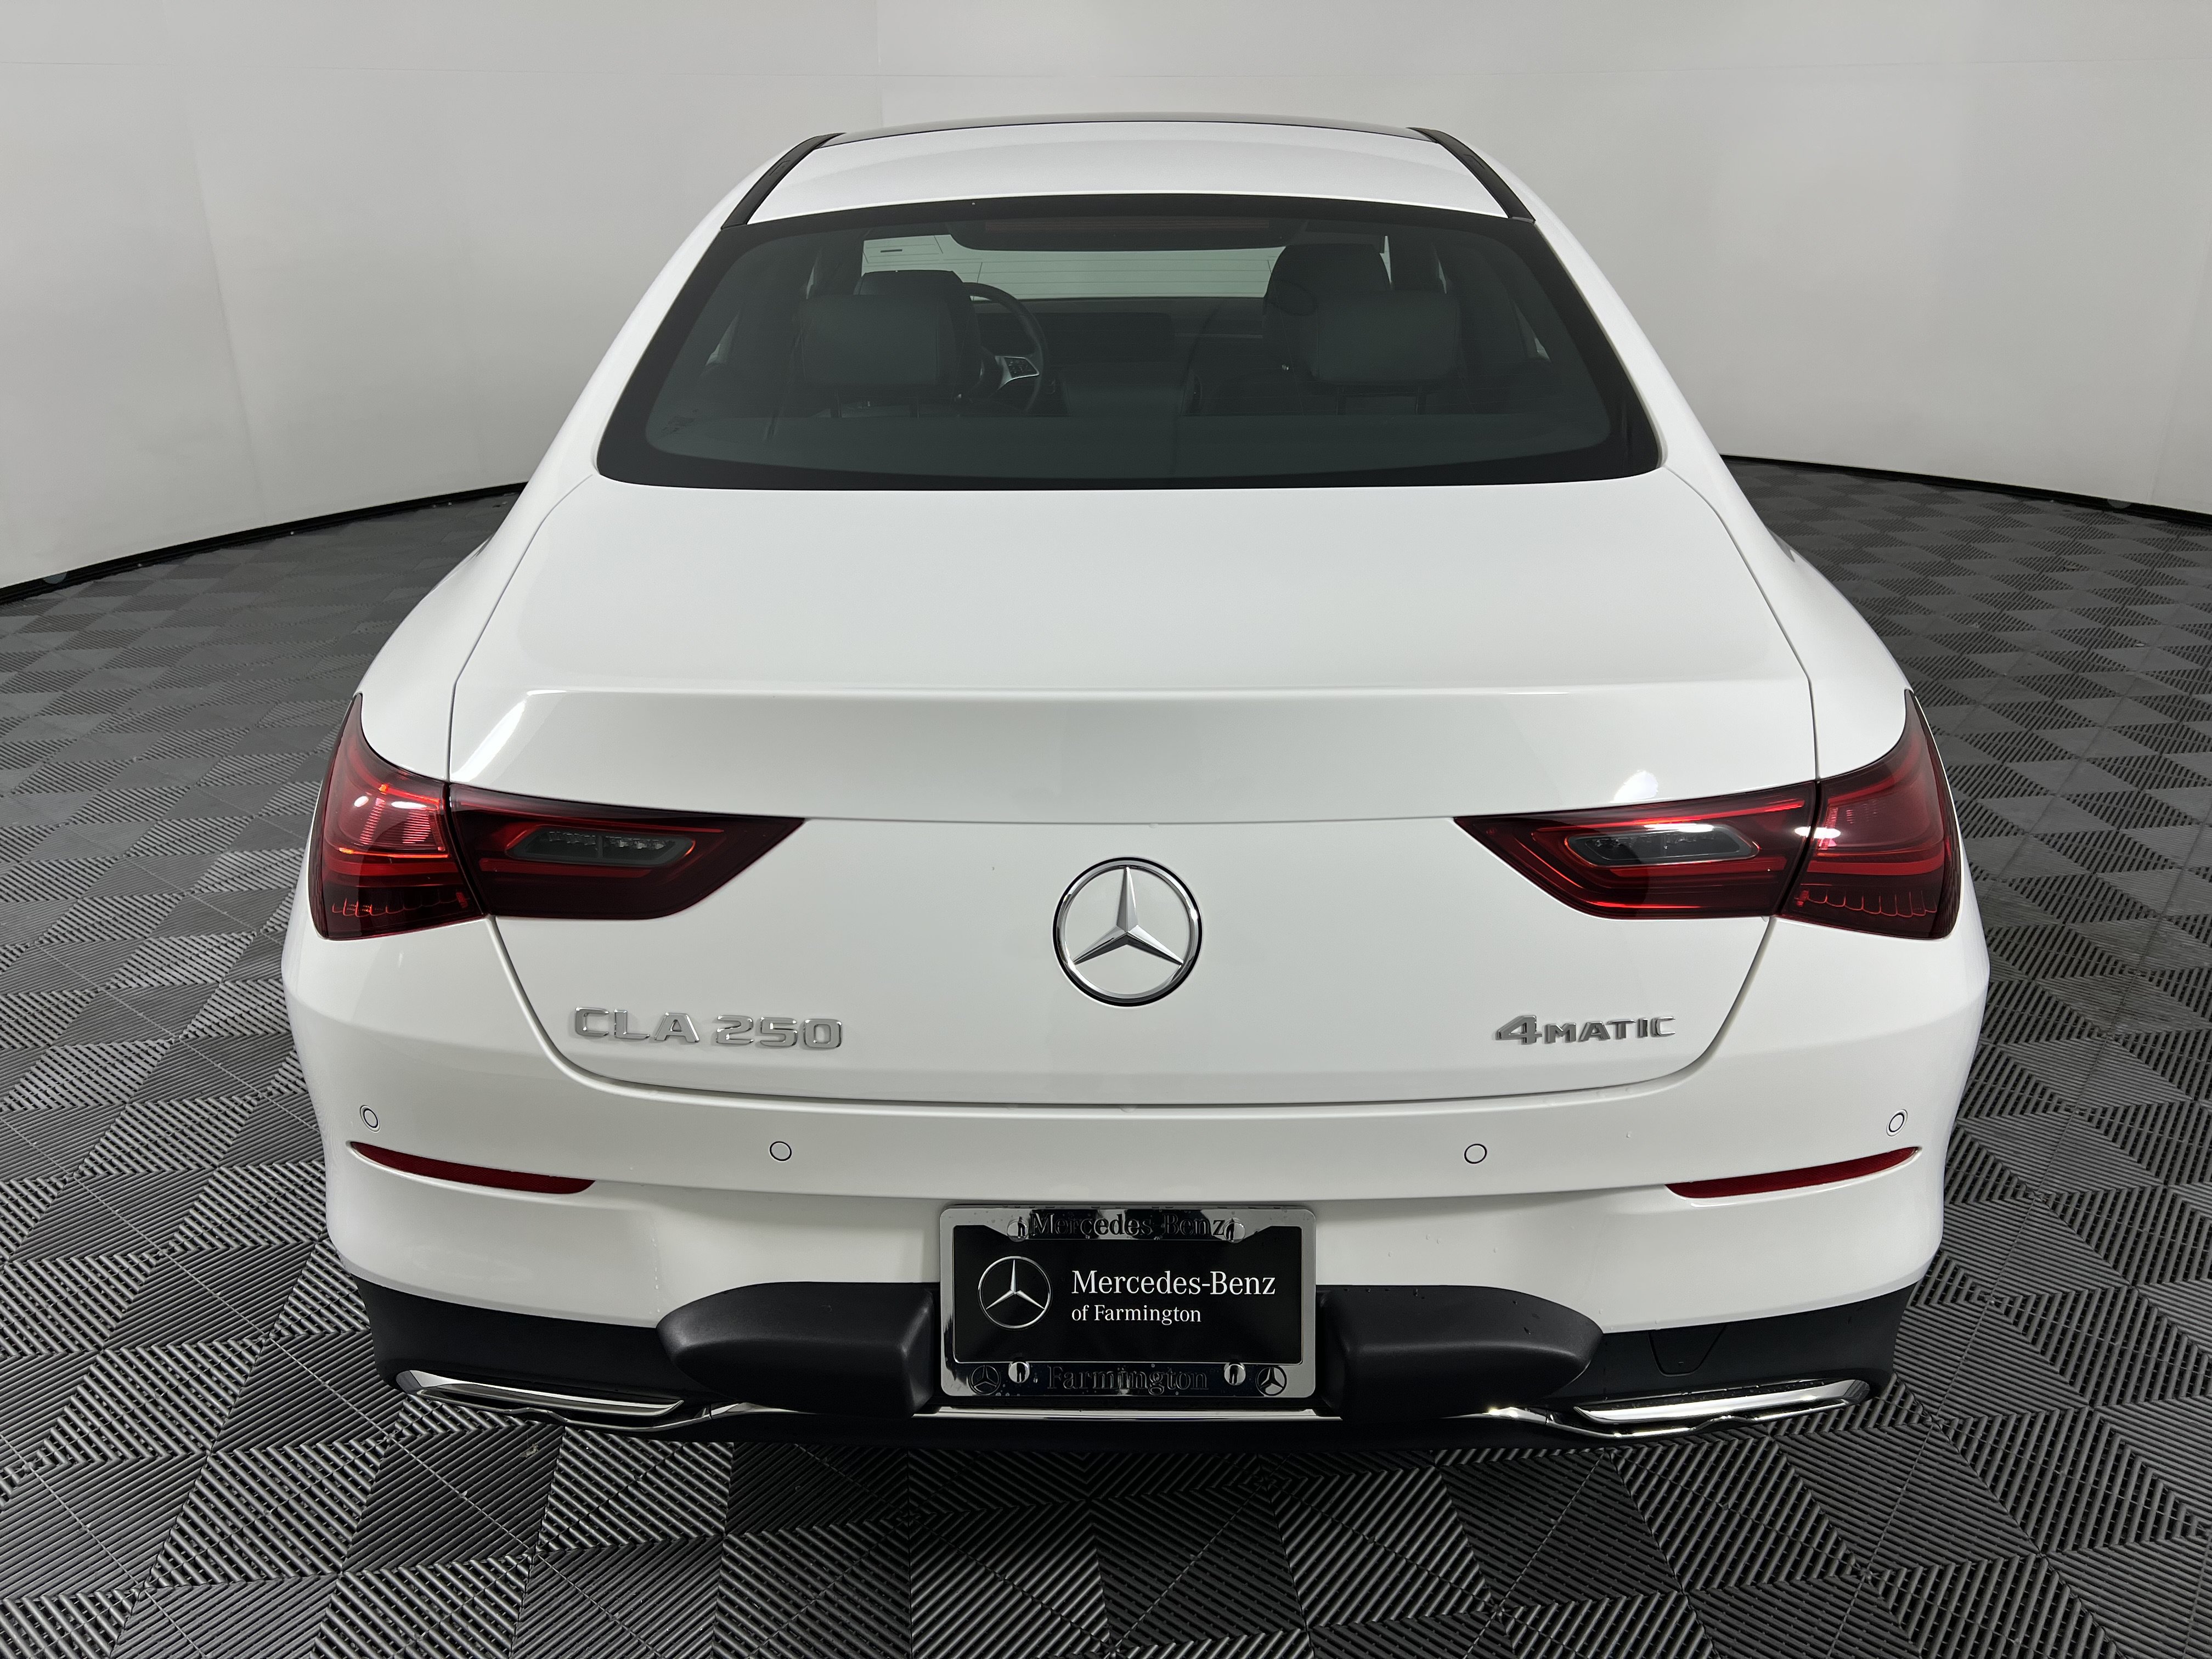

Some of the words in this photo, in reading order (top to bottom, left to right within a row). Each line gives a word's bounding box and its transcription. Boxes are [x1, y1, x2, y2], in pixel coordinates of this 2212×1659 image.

[575, 1007, 699, 1043] CLA
[716, 1014, 842, 1048] 250
[1496, 1014, 1676, 1044] 4MATIC
[1071, 1269, 1276, 1295] Mercedes-Benz
[1071, 1305, 1090, 1322] of
[1094, 1305, 1201, 1325] Farmington
[1047, 1366, 1208, 1396] Farmington
